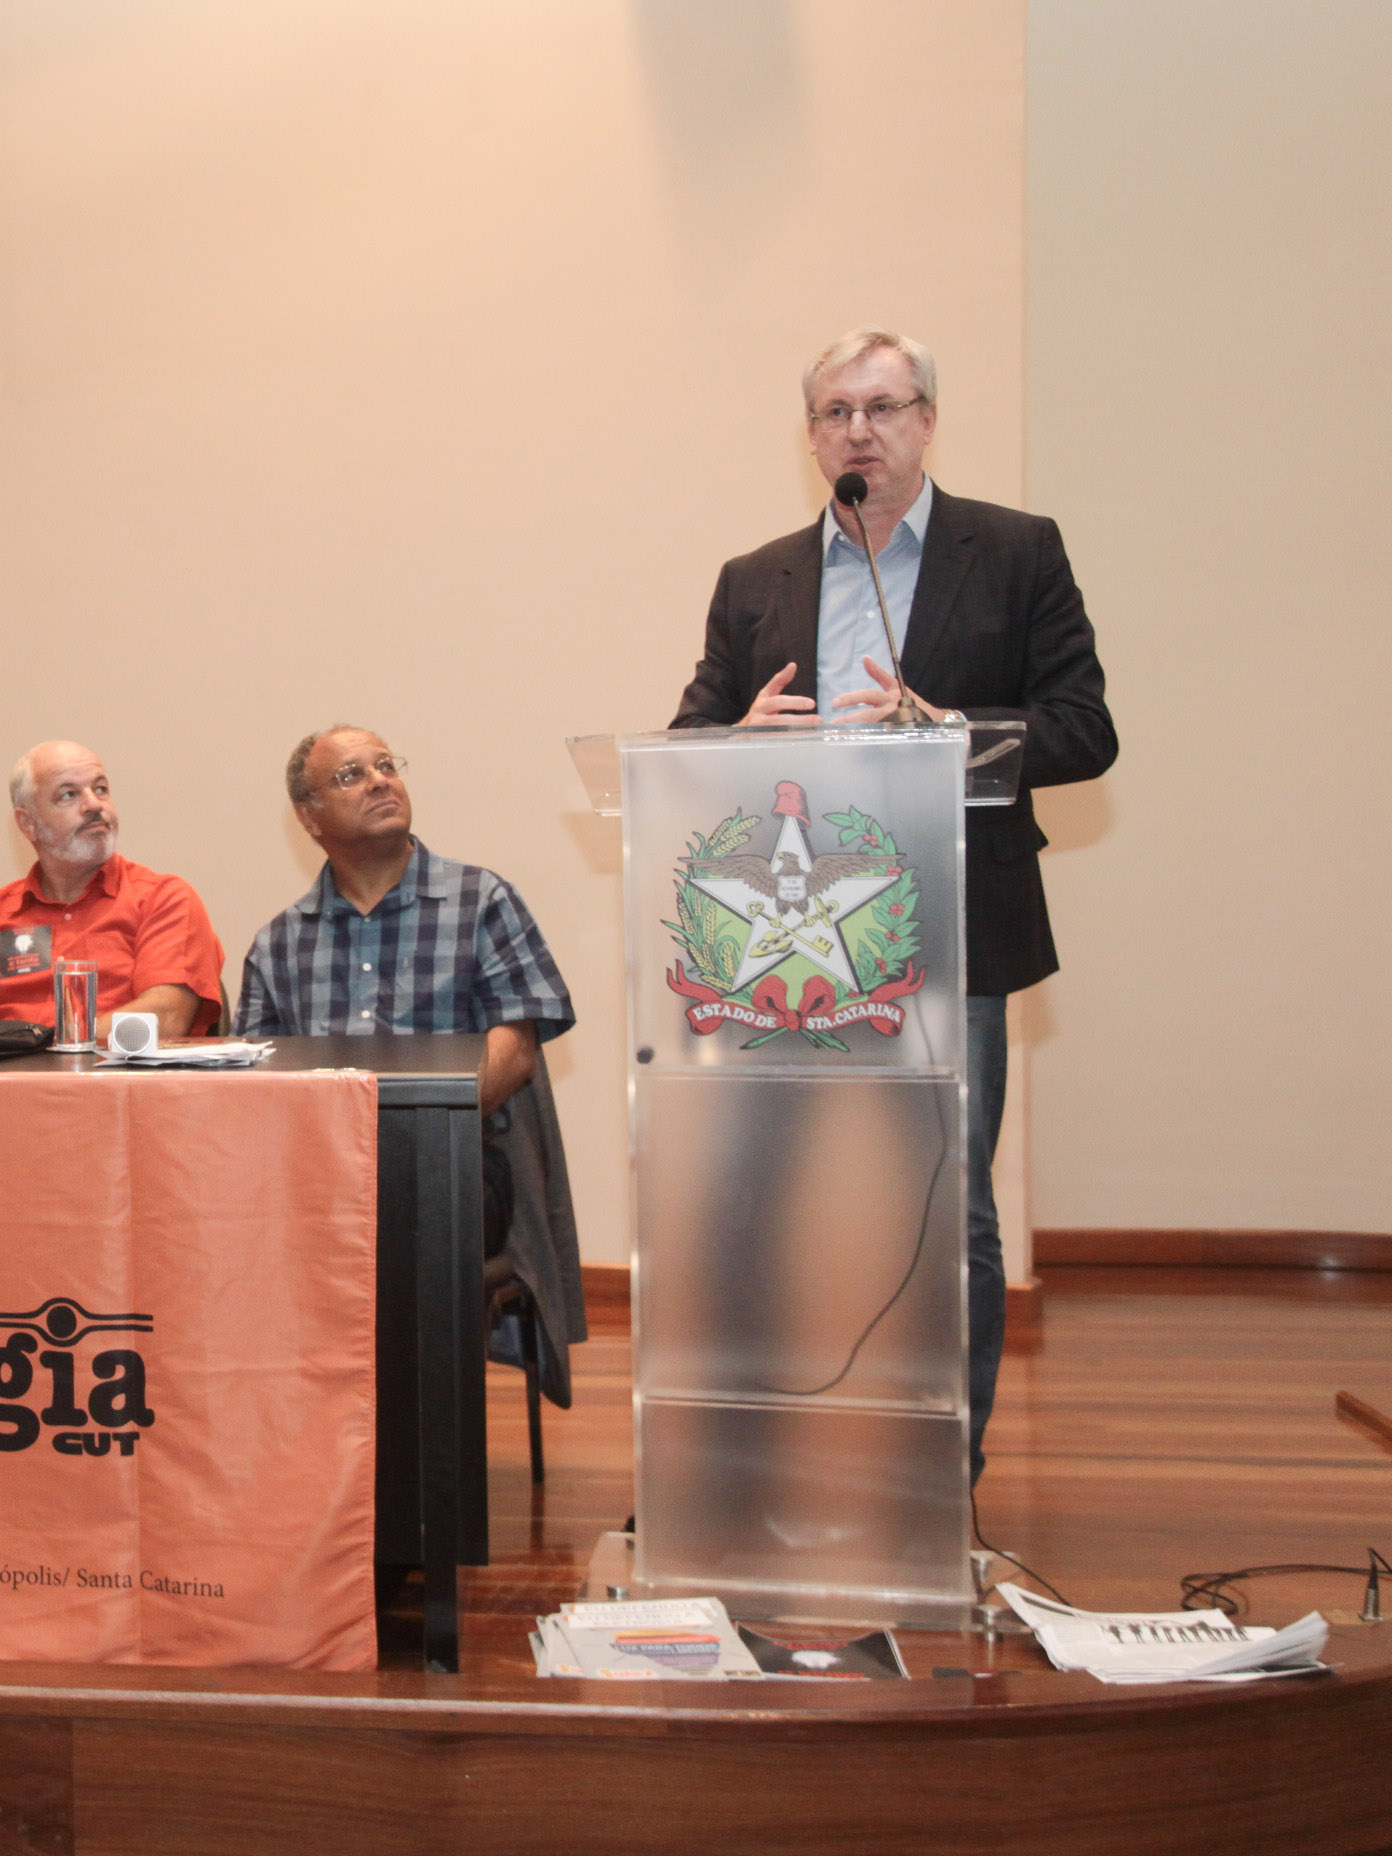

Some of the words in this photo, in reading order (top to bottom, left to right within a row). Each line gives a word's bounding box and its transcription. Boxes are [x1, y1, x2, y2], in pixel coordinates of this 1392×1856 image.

[693, 1003, 756, 1024] ESTADO
[755, 1015, 777, 1028] DE
[51, 1431, 141, 1456] CUT
[76, 1567, 133, 1589] Santa
[139, 1569, 225, 1598] Catarina
